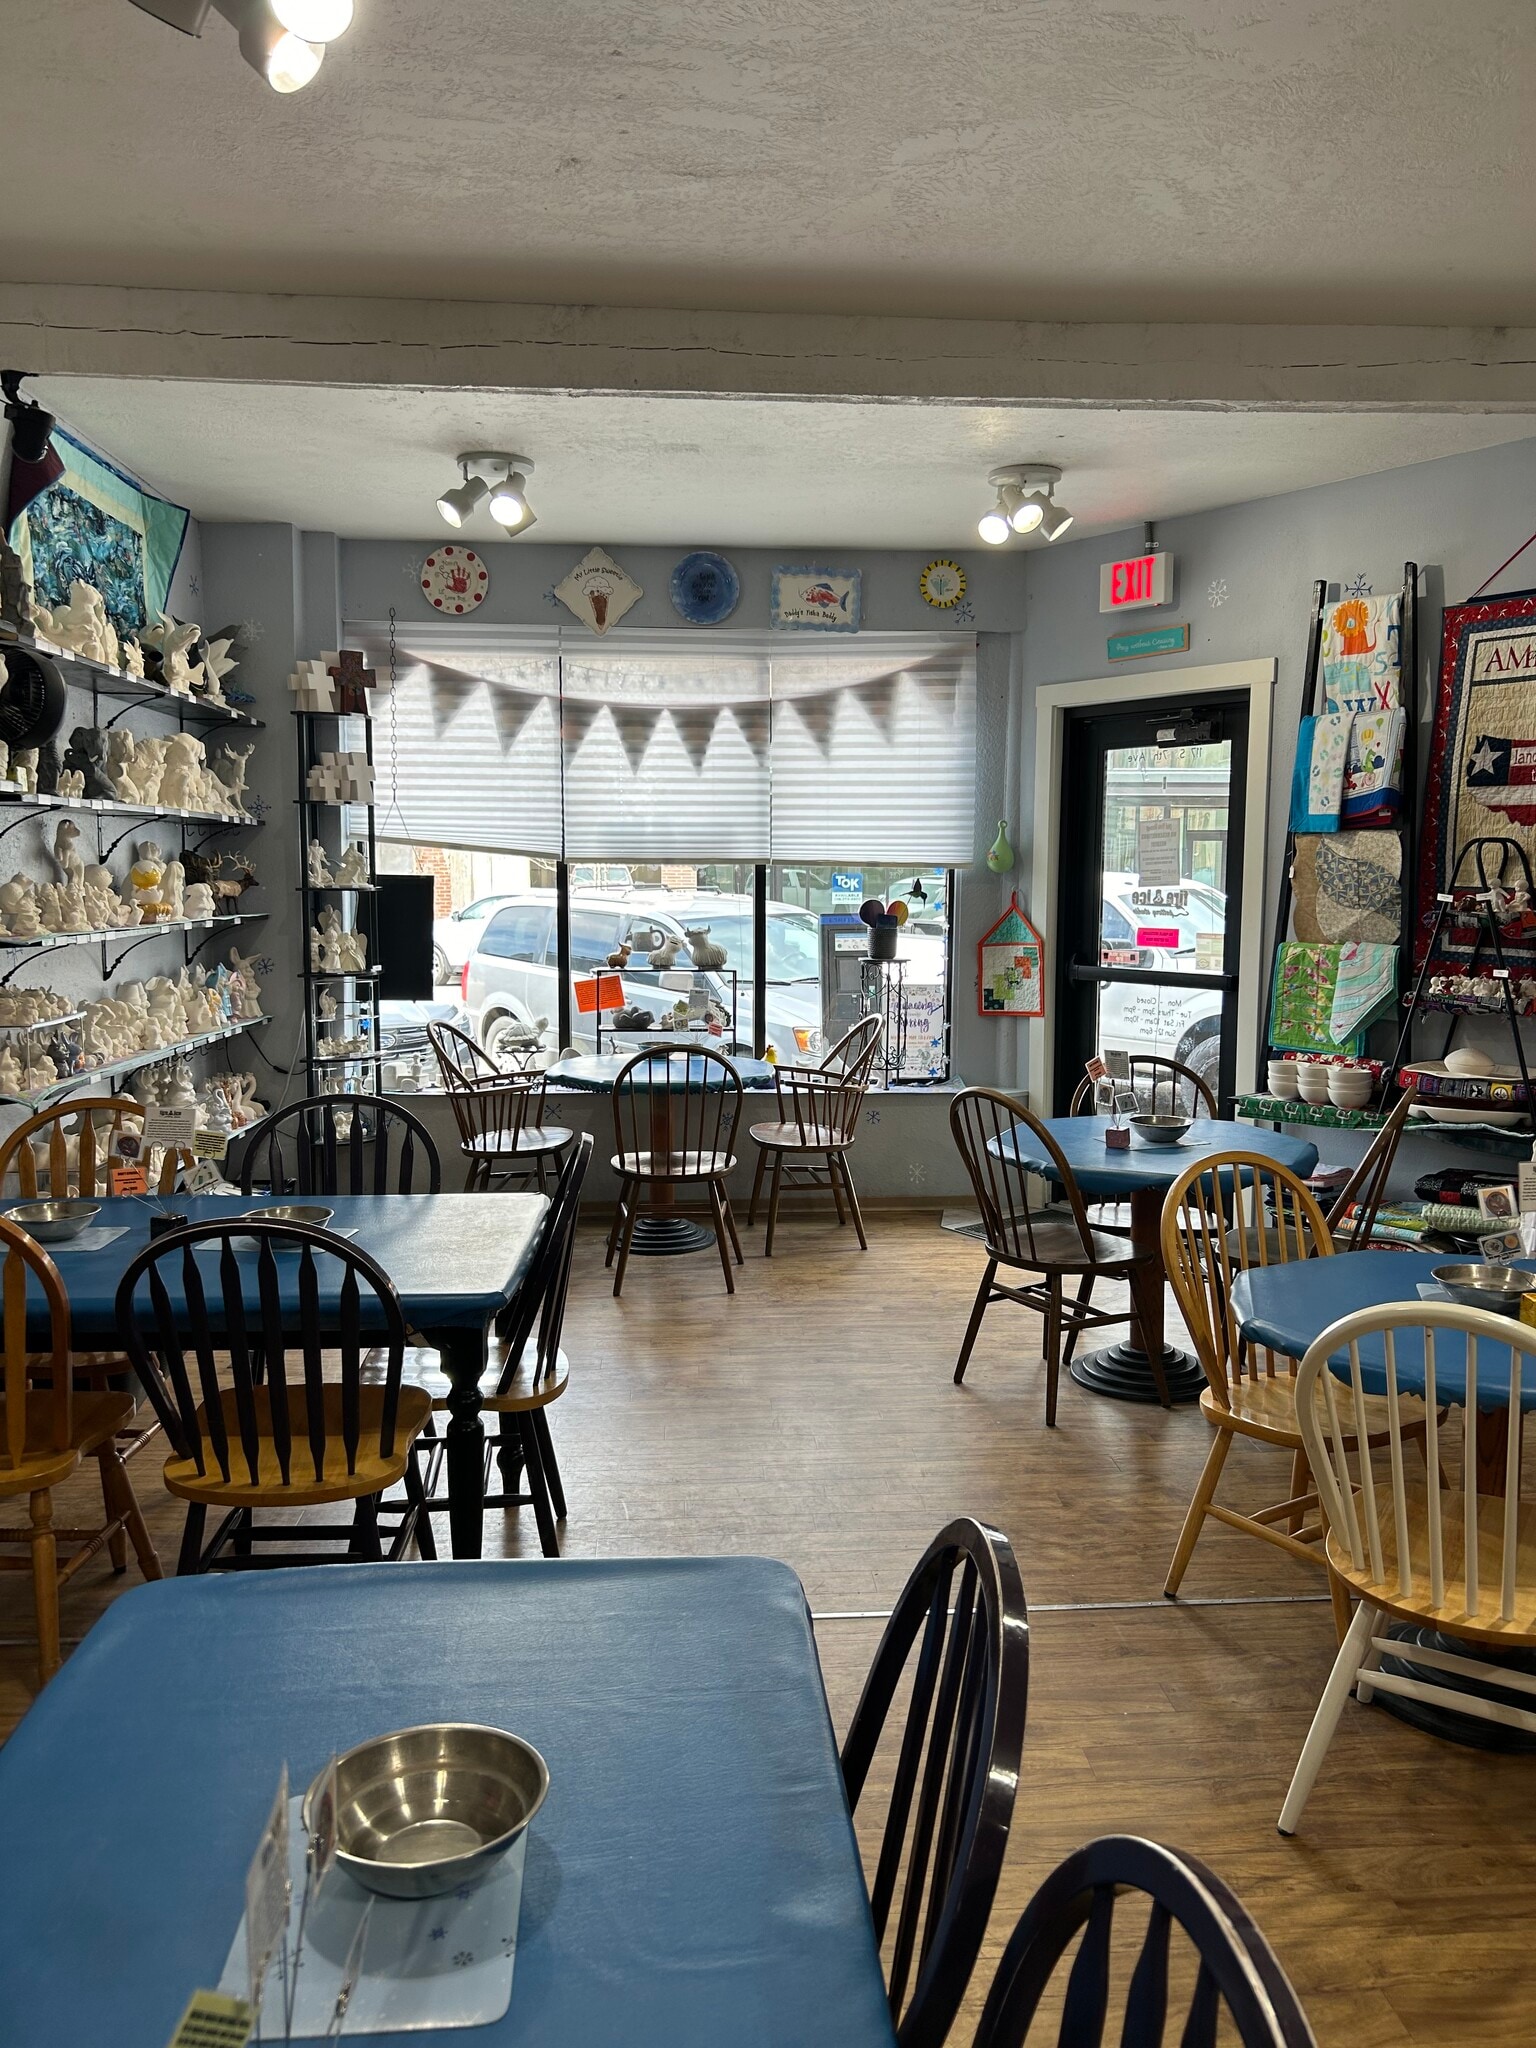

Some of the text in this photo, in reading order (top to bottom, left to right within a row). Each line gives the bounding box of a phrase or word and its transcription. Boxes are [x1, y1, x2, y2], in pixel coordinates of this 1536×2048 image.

[574, 572, 582, 581] My
[583, 567, 600, 576] Little
[1112, 556, 1156, 606] EXIT
[784, 608, 803, 618] Daddy's
[822, 611, 837, 623] Buddy
[835, 875, 860, 891] TOK
